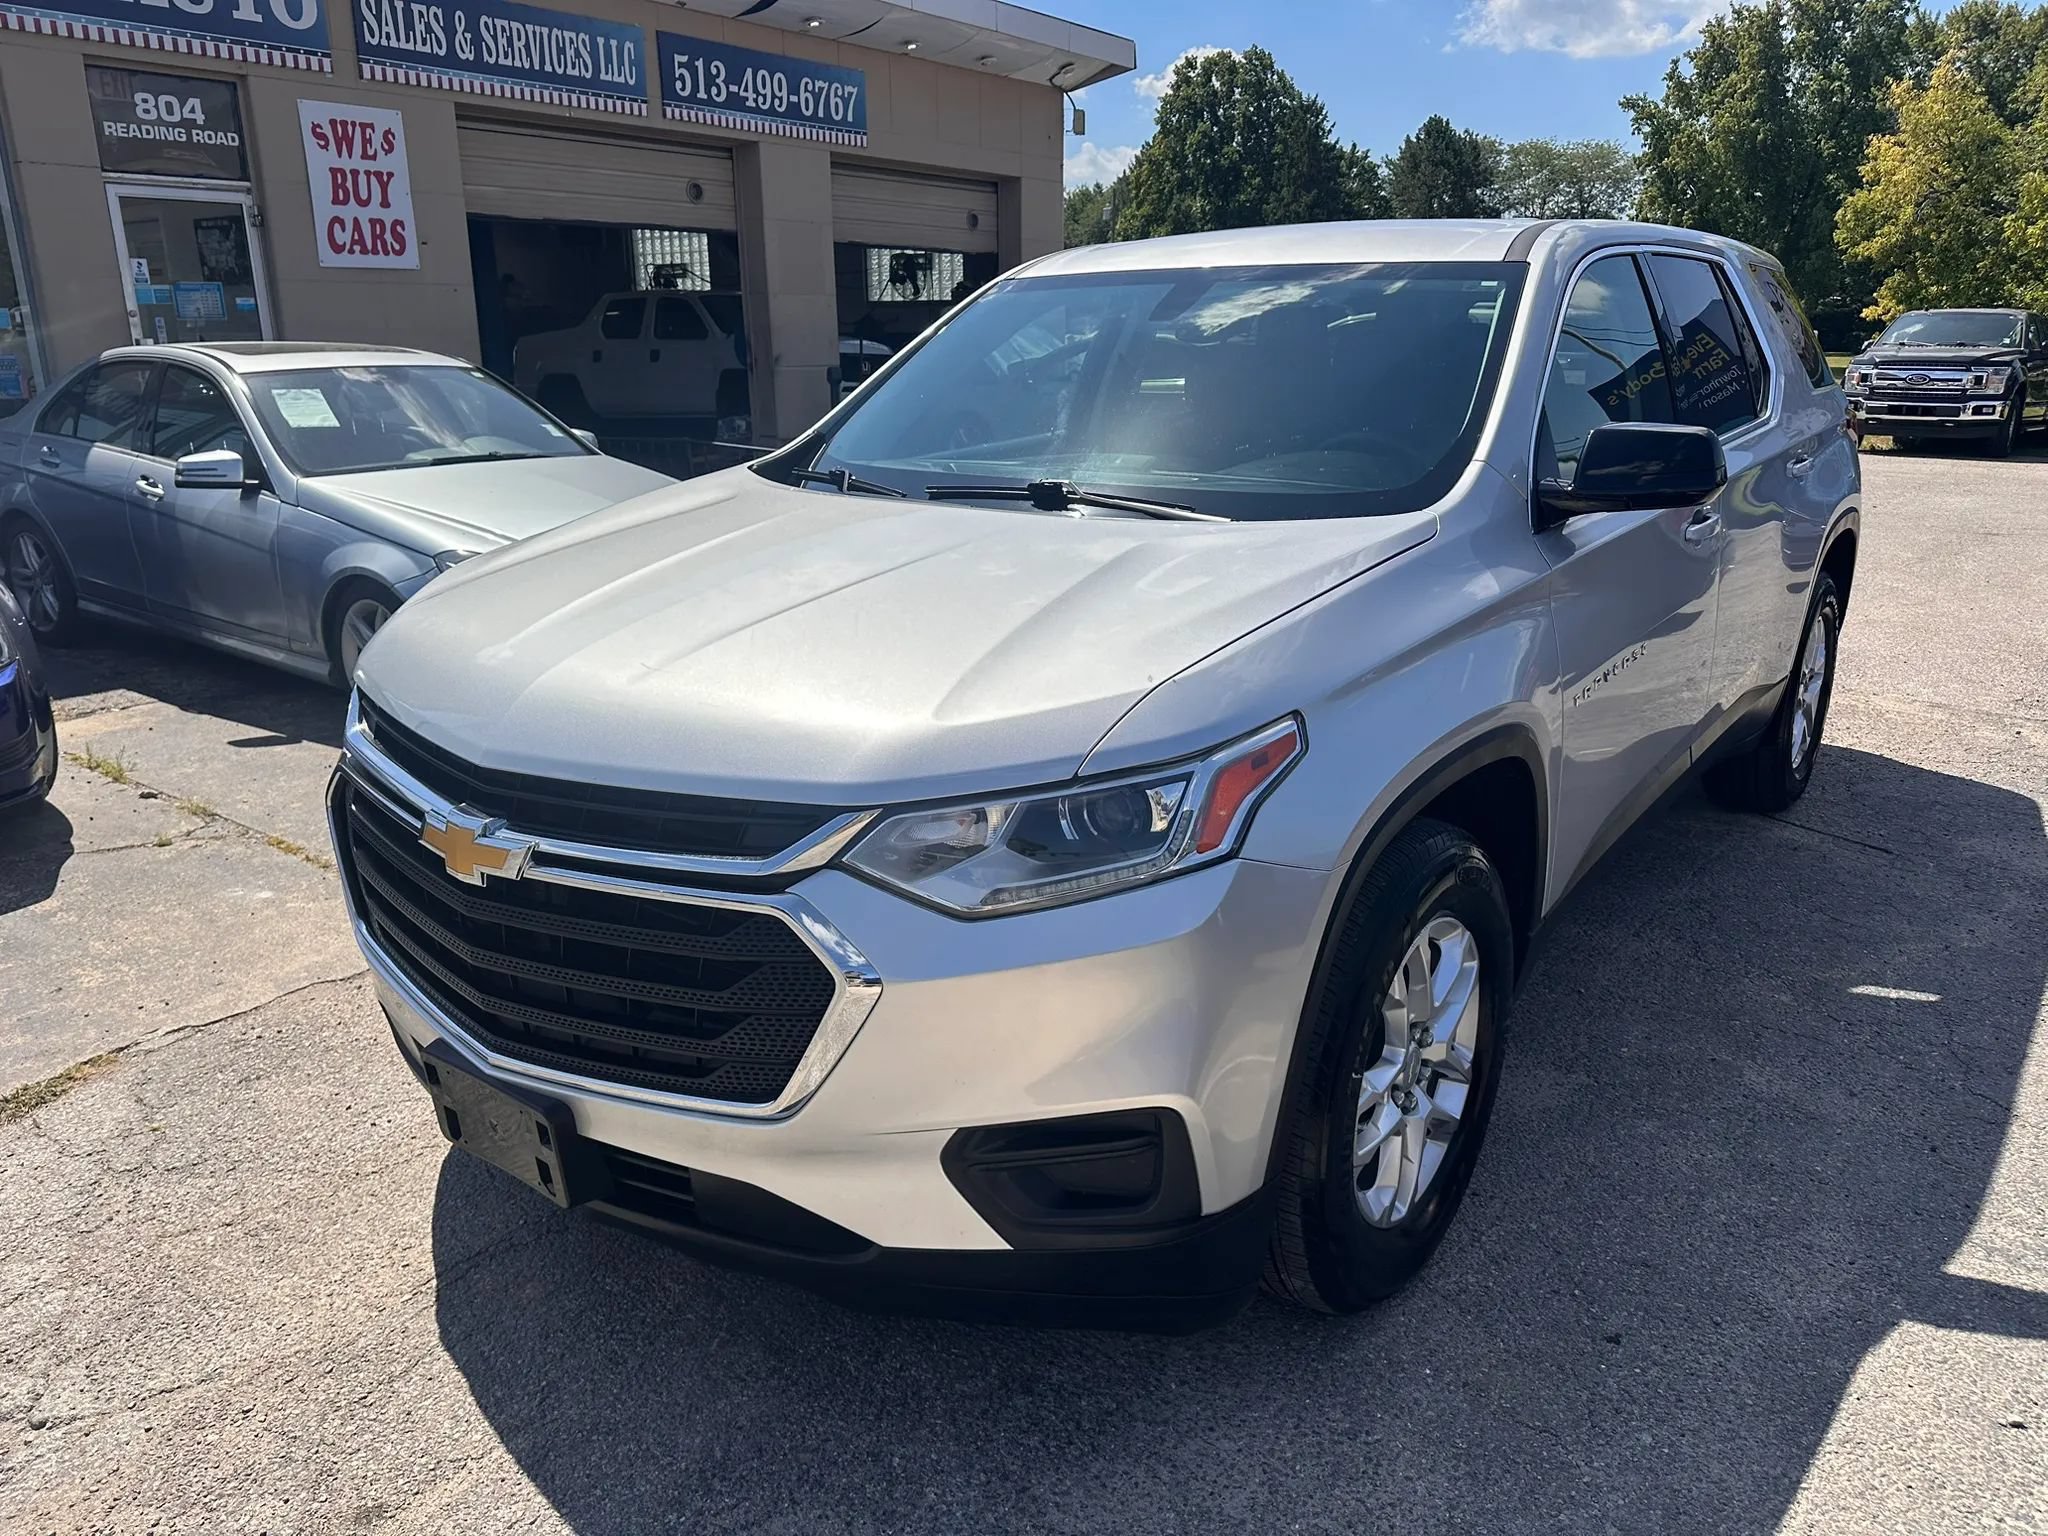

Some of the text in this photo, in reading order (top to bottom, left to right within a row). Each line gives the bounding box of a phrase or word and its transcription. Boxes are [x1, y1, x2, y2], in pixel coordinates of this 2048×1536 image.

[360, 0, 447, 57] SALES
[453, 9, 475, 62] &
[479, 14, 594, 79] SERVICES
[596, 36, 636, 86] LLC
[133, 91, 206, 125] 804
[674, 52, 858, 122] 513-499-6767
[102, 121, 240, 147] READING ROAD
[328, 166, 395, 209] BUY
[326, 215, 407, 257] CARS
